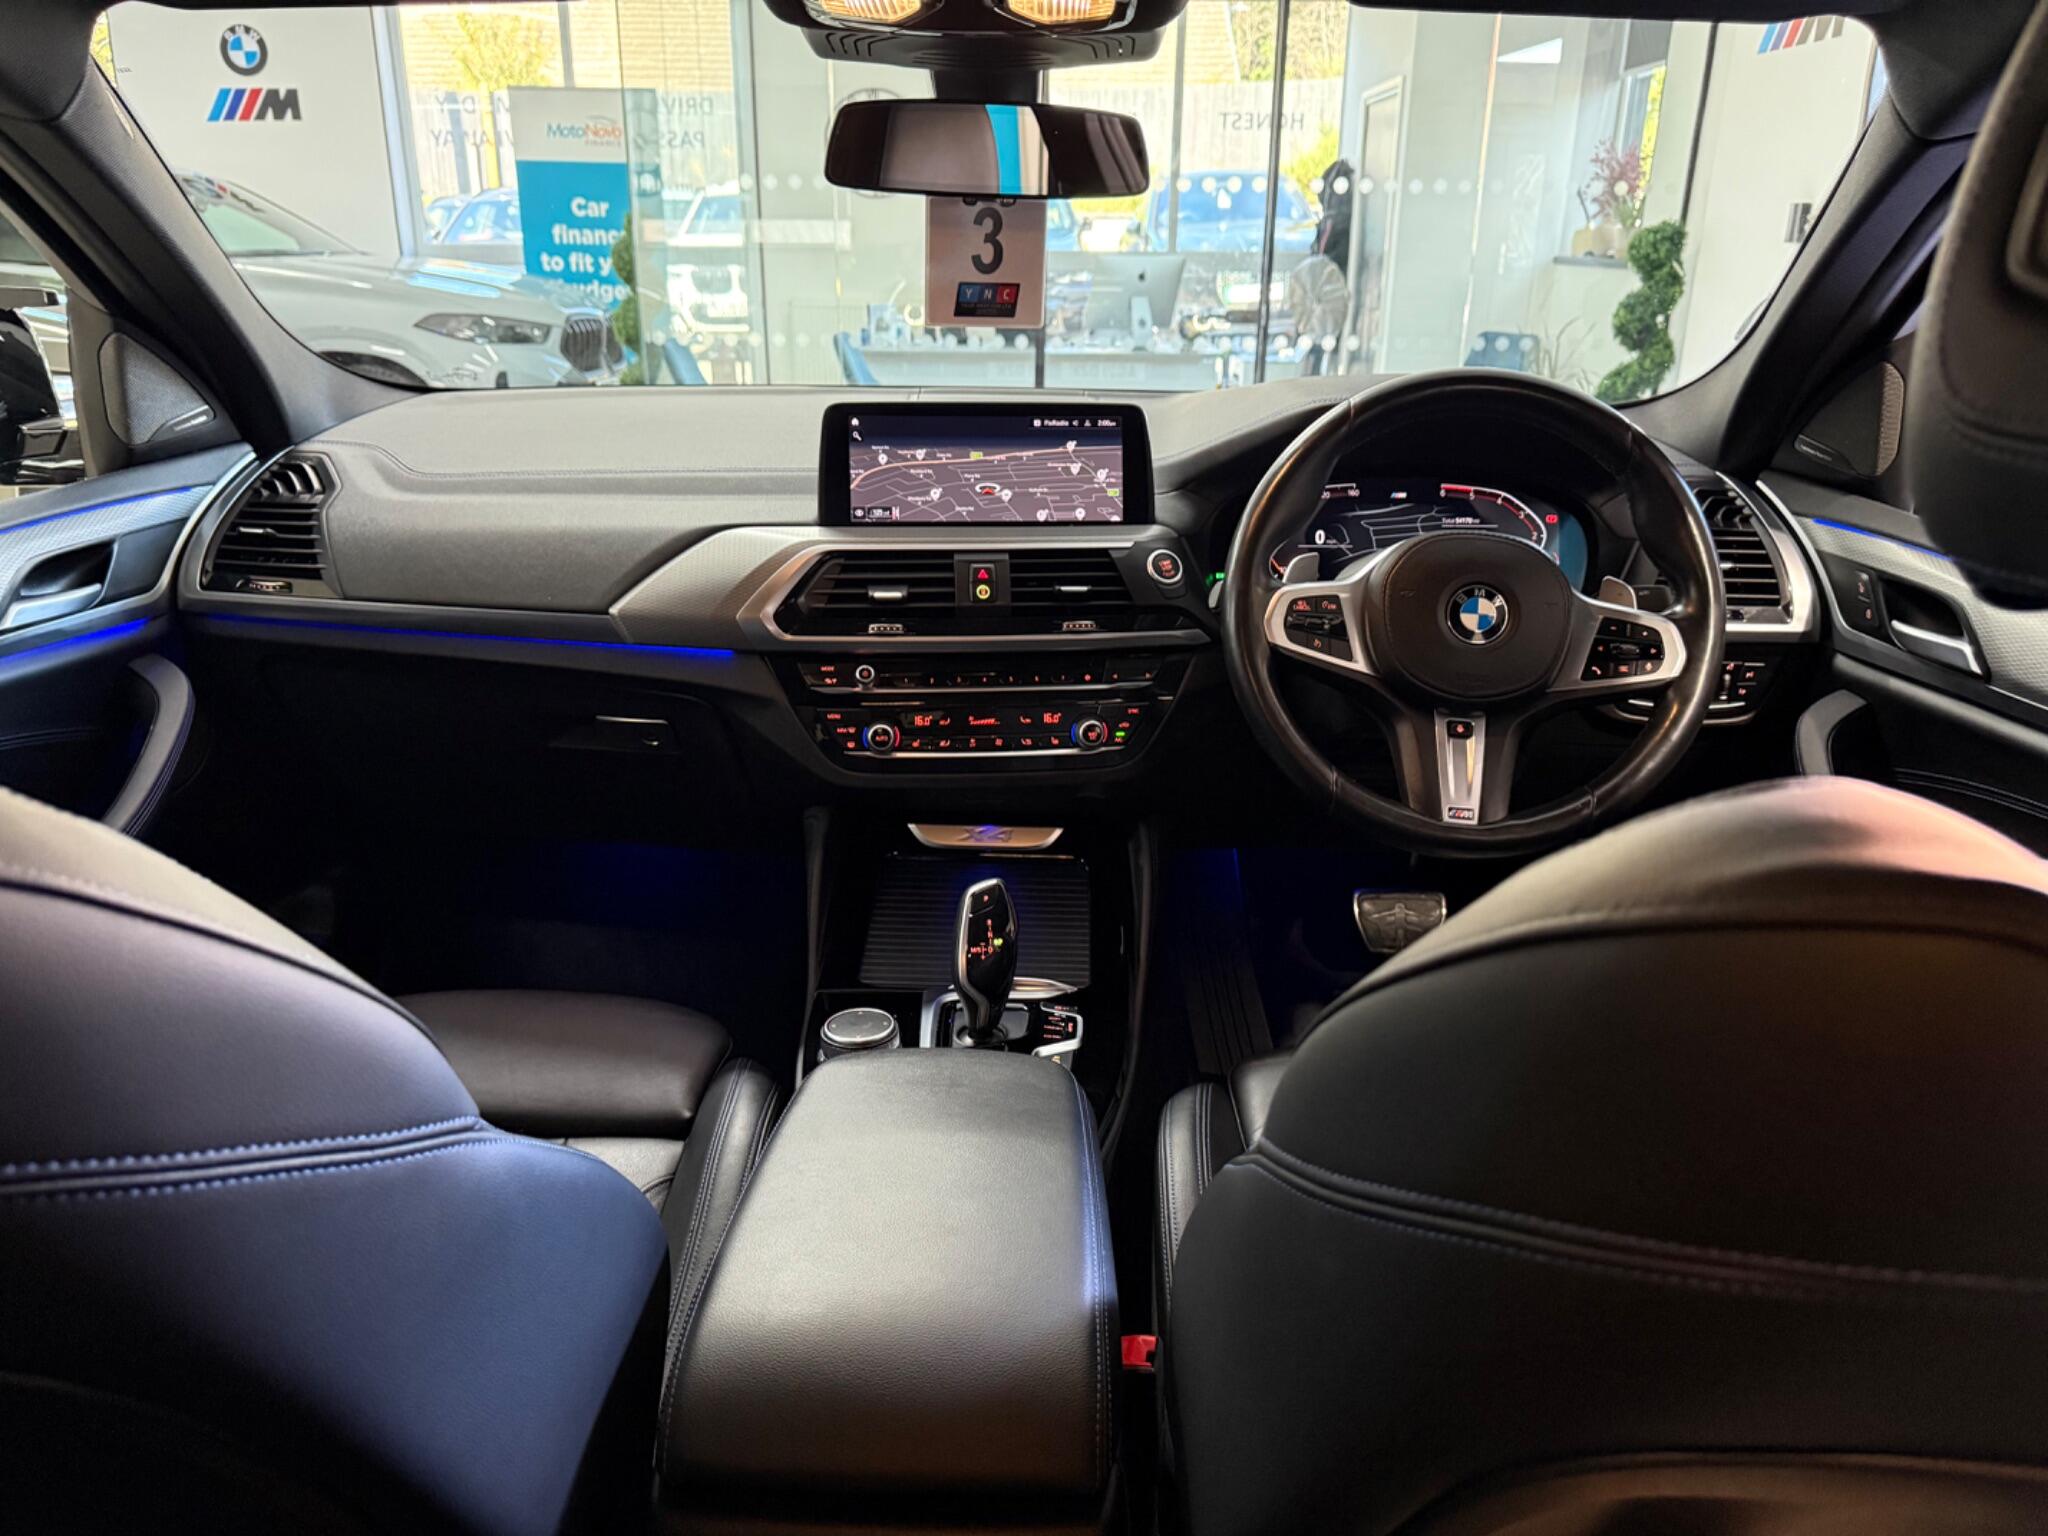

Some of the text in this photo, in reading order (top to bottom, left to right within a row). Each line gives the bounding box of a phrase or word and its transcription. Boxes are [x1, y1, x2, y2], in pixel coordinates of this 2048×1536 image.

[570, 196, 610, 218] Car
[551, 223, 626, 246] financ
[971, 206, 1004, 275] 3
[541, 251, 565, 272] to
[568, 251, 595, 273] fit
